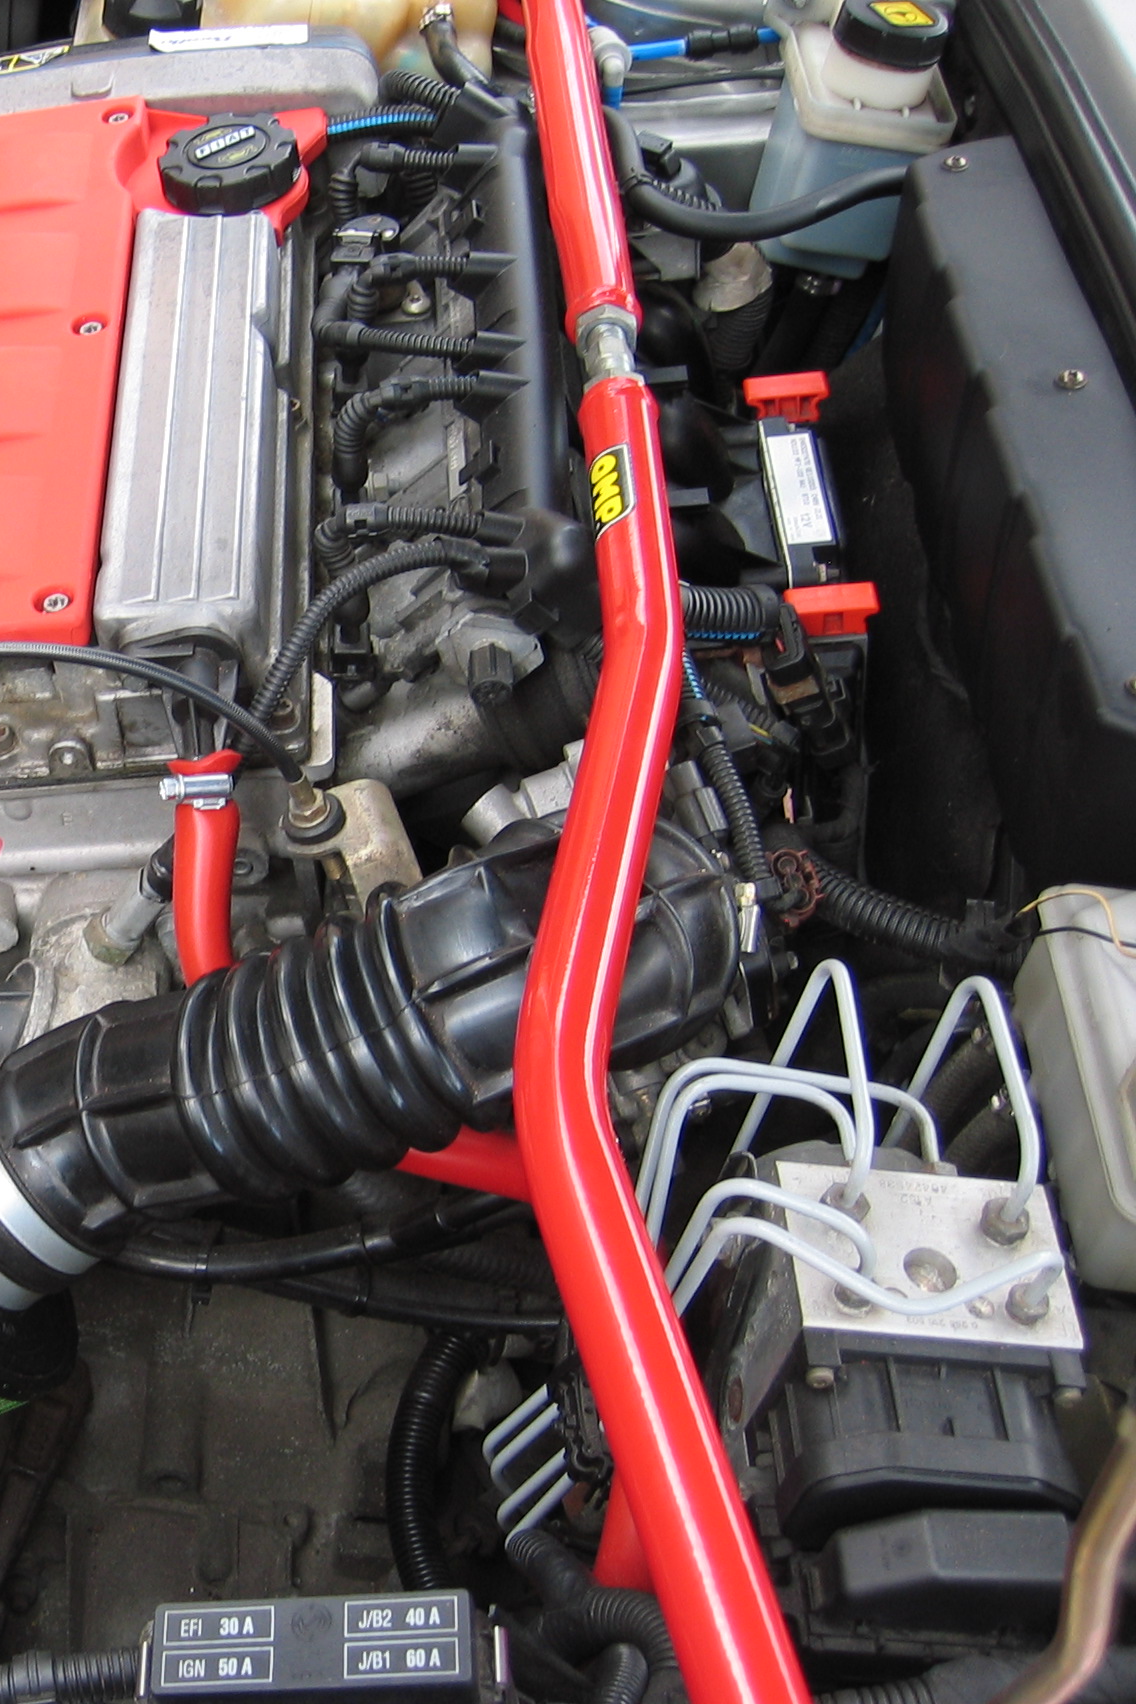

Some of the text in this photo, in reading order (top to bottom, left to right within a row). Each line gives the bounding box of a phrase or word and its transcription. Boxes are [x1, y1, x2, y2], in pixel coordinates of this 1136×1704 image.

[195, 126, 255, 159] FIAT
[590, 454, 623, 524] OMP
[180, 1616, 254, 1638] EFI 30 A
[358, 1606, 441, 1629] J/B2 40 A
[178, 1657, 253, 1679] IGN 50 A
[358, 1648, 441, 1671] J/B1 60 A
